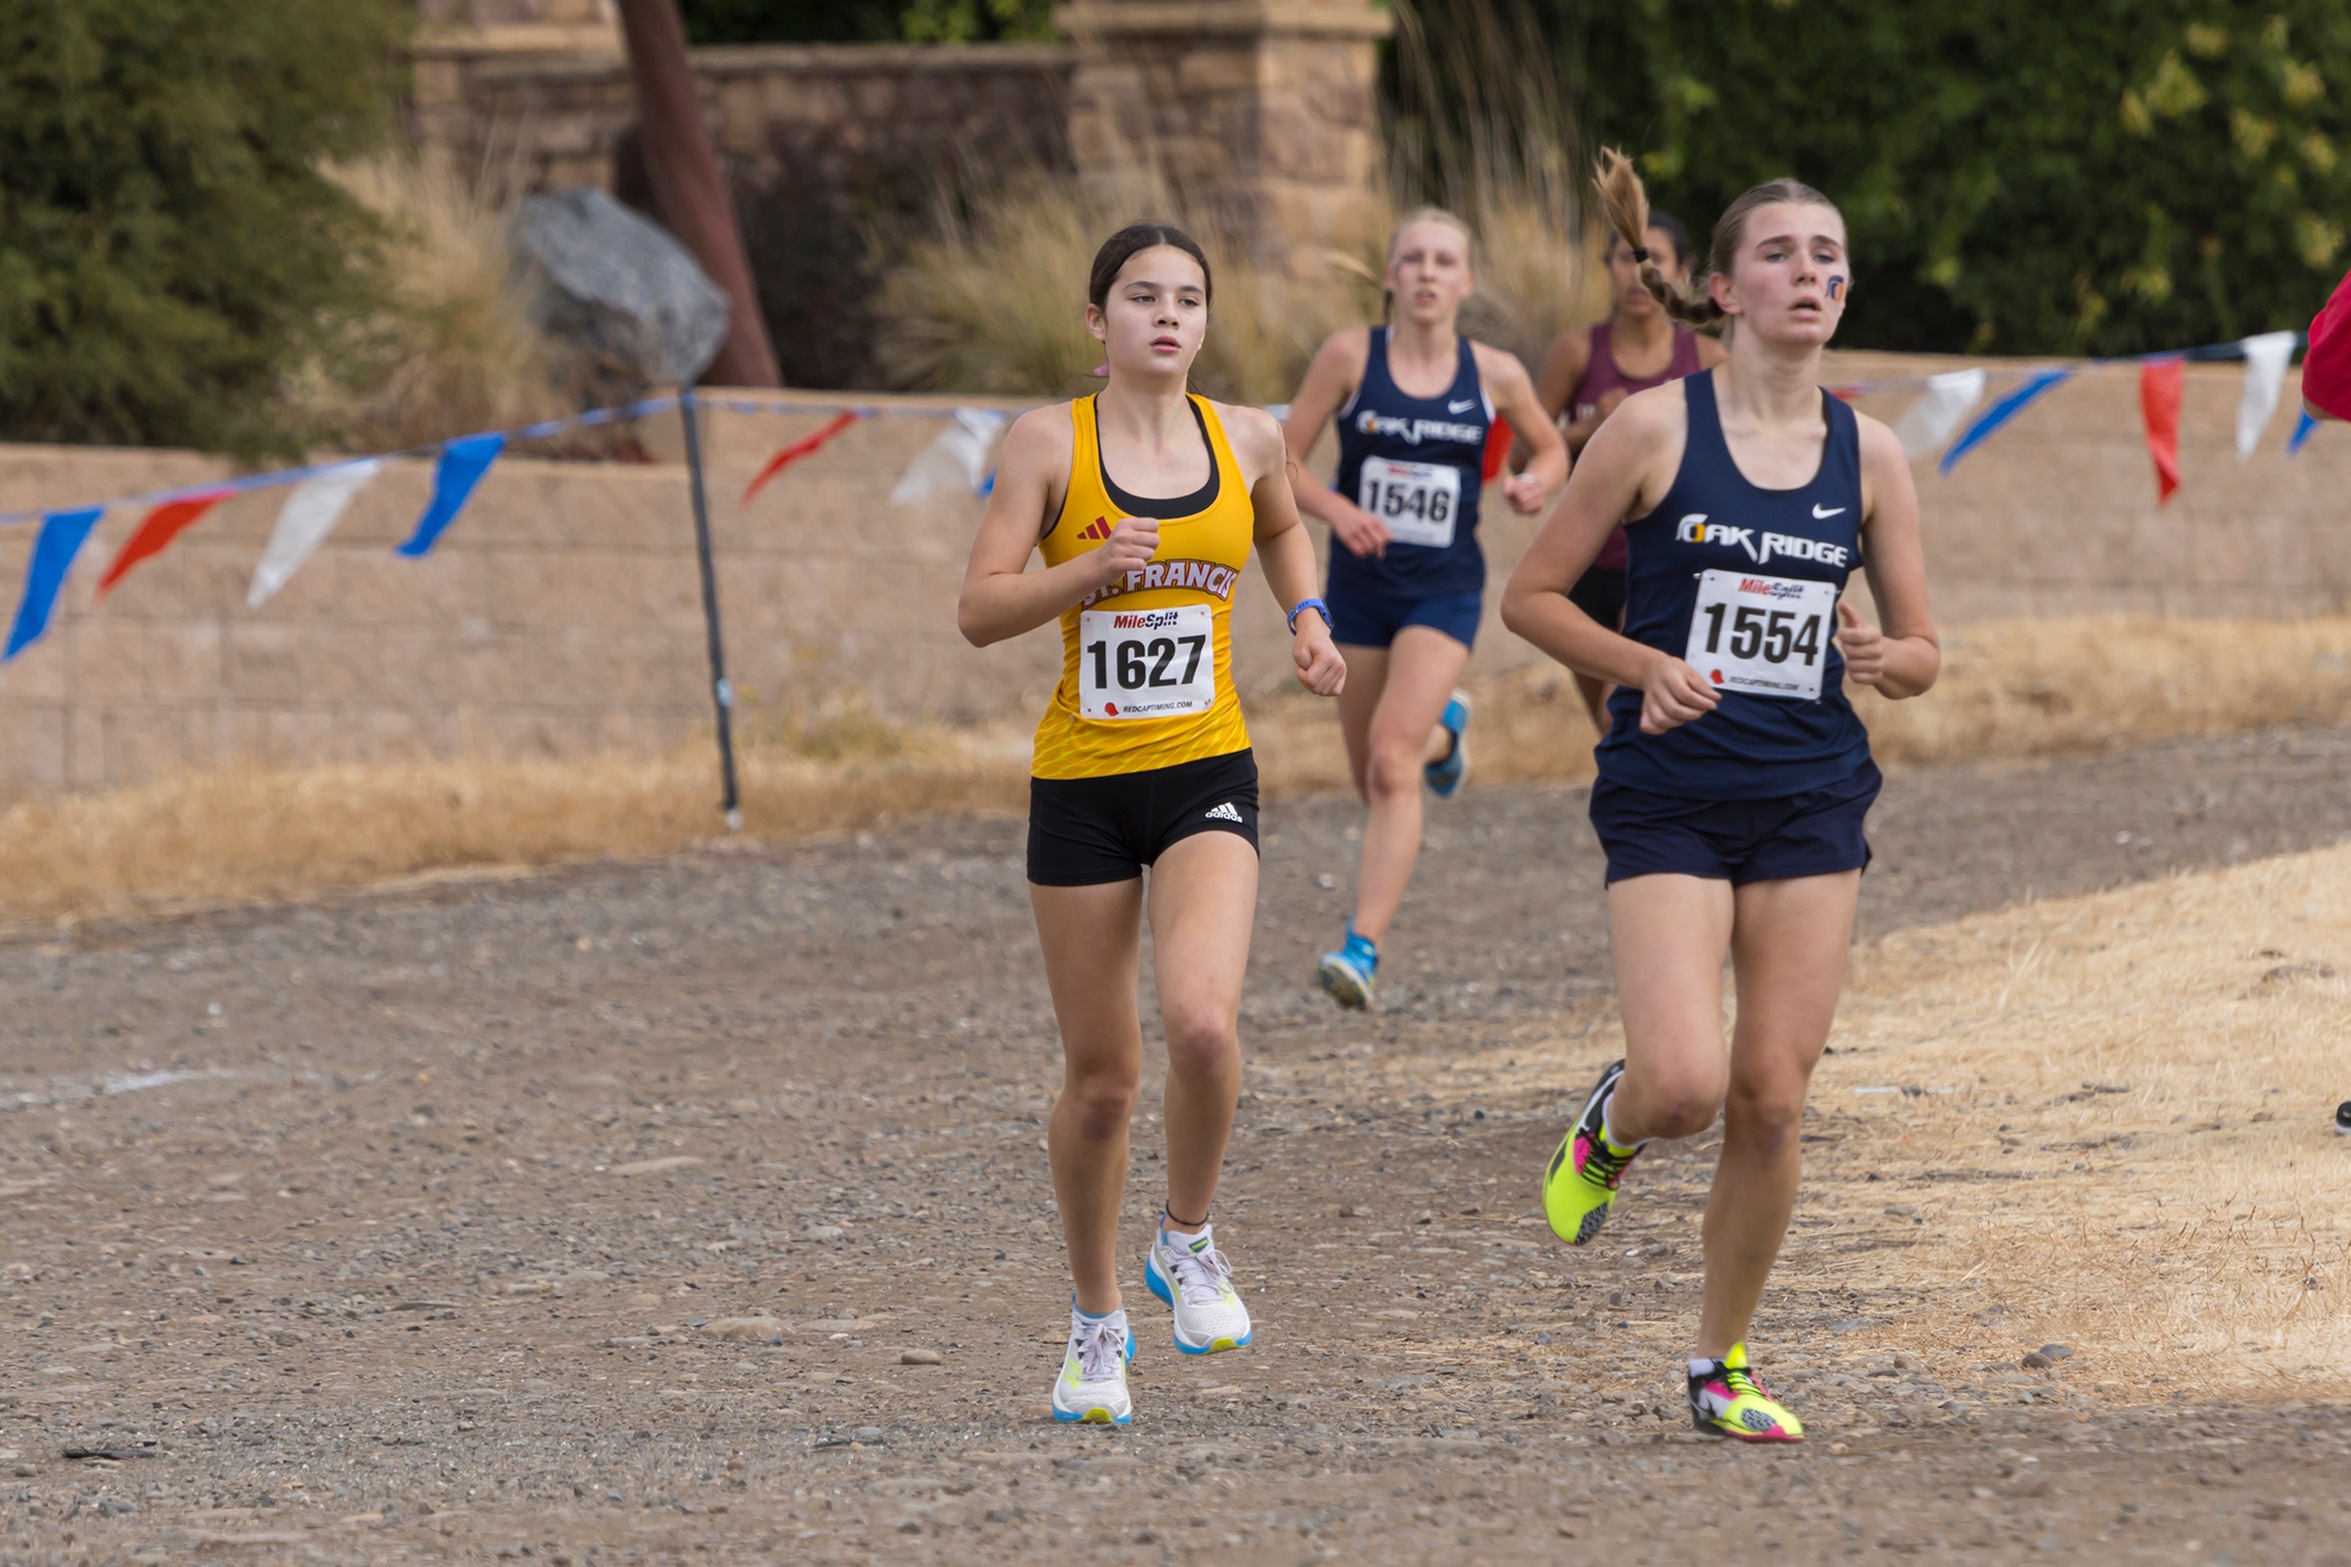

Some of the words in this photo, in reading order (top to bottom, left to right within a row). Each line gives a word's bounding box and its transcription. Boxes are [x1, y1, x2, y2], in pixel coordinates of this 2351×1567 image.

[1368, 479, 1450, 523] 1546
[1676, 513, 1759, 562] OAK
[1758, 531, 1848, 567] RIDGE
[1113, 611, 1179, 630] MileSplit
[1704, 602, 1822, 666] 1554
[1087, 634, 1206, 690] 1627
[1123, 701, 1193, 713] REDCAPTIMING.COM
